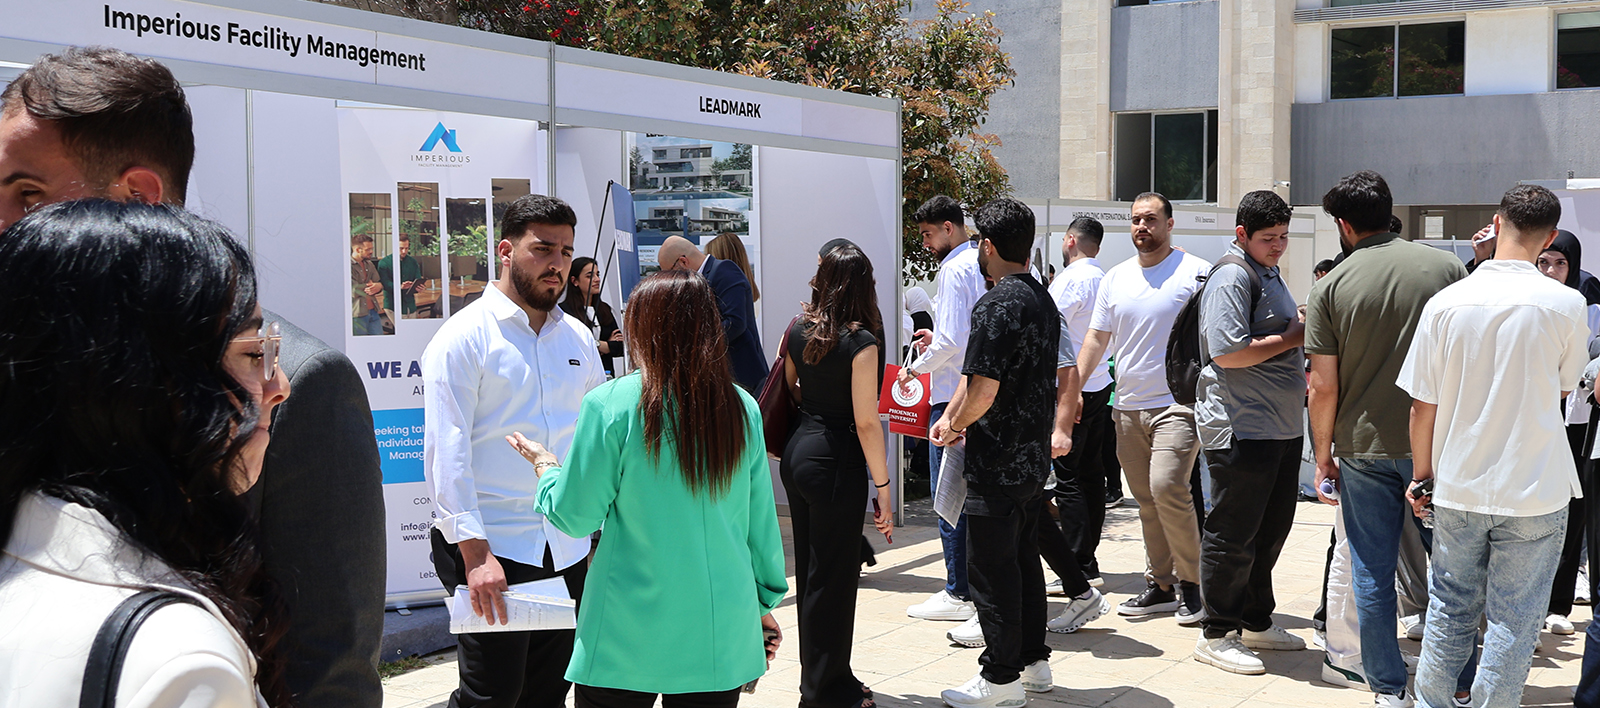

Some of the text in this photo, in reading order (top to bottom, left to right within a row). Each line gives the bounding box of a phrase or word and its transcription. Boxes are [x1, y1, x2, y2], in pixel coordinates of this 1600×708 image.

[103, 4, 426, 72] Imperious Facility Management
[699, 95, 762, 118] LEADMARK
[410, 154, 471, 163] IMPERIOUS
[1100, 212, 1127, 221] INTERNATIONAL
[366, 360, 423, 379] WE A
[888, 407, 919, 418] PHOENICIA
